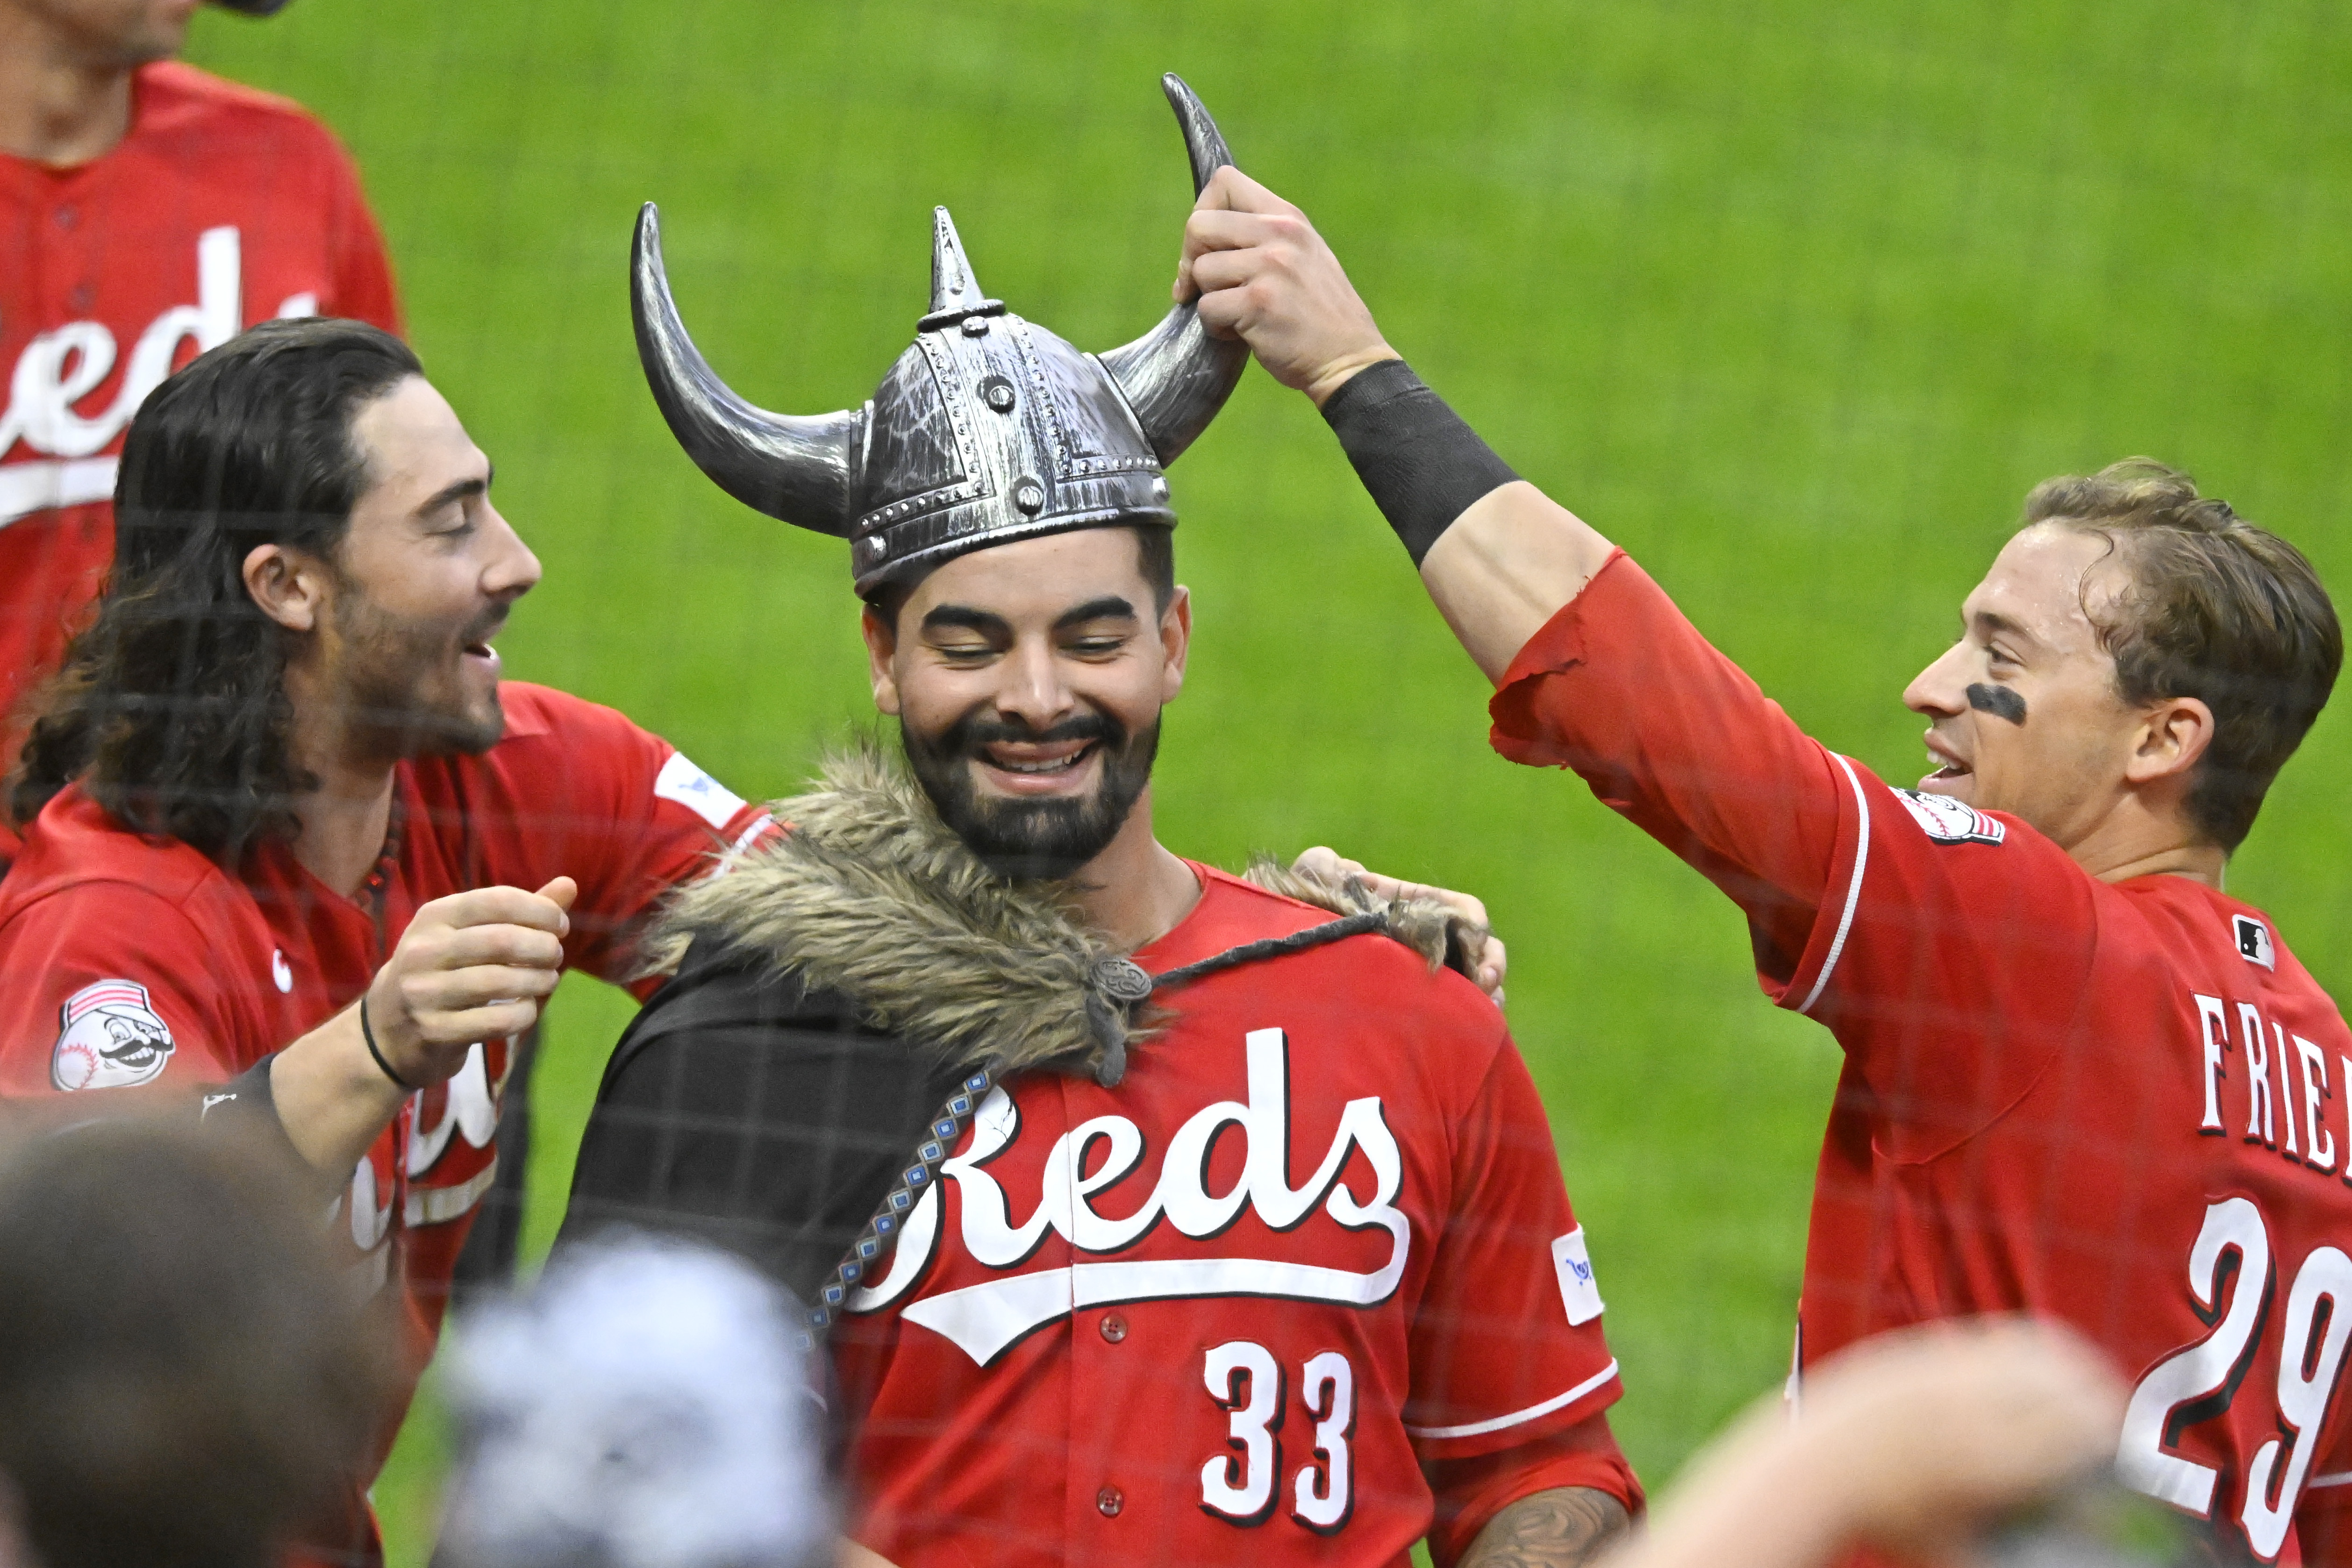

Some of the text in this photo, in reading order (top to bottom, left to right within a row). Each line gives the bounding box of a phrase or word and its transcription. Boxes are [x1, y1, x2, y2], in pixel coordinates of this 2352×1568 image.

[847, 1026, 1411, 1315] Reds
[2190, 990, 2352, 1187] FRIE
[1198, 1340, 1358, 1536] 33
[2114, 1196, 2352, 1561] 29
